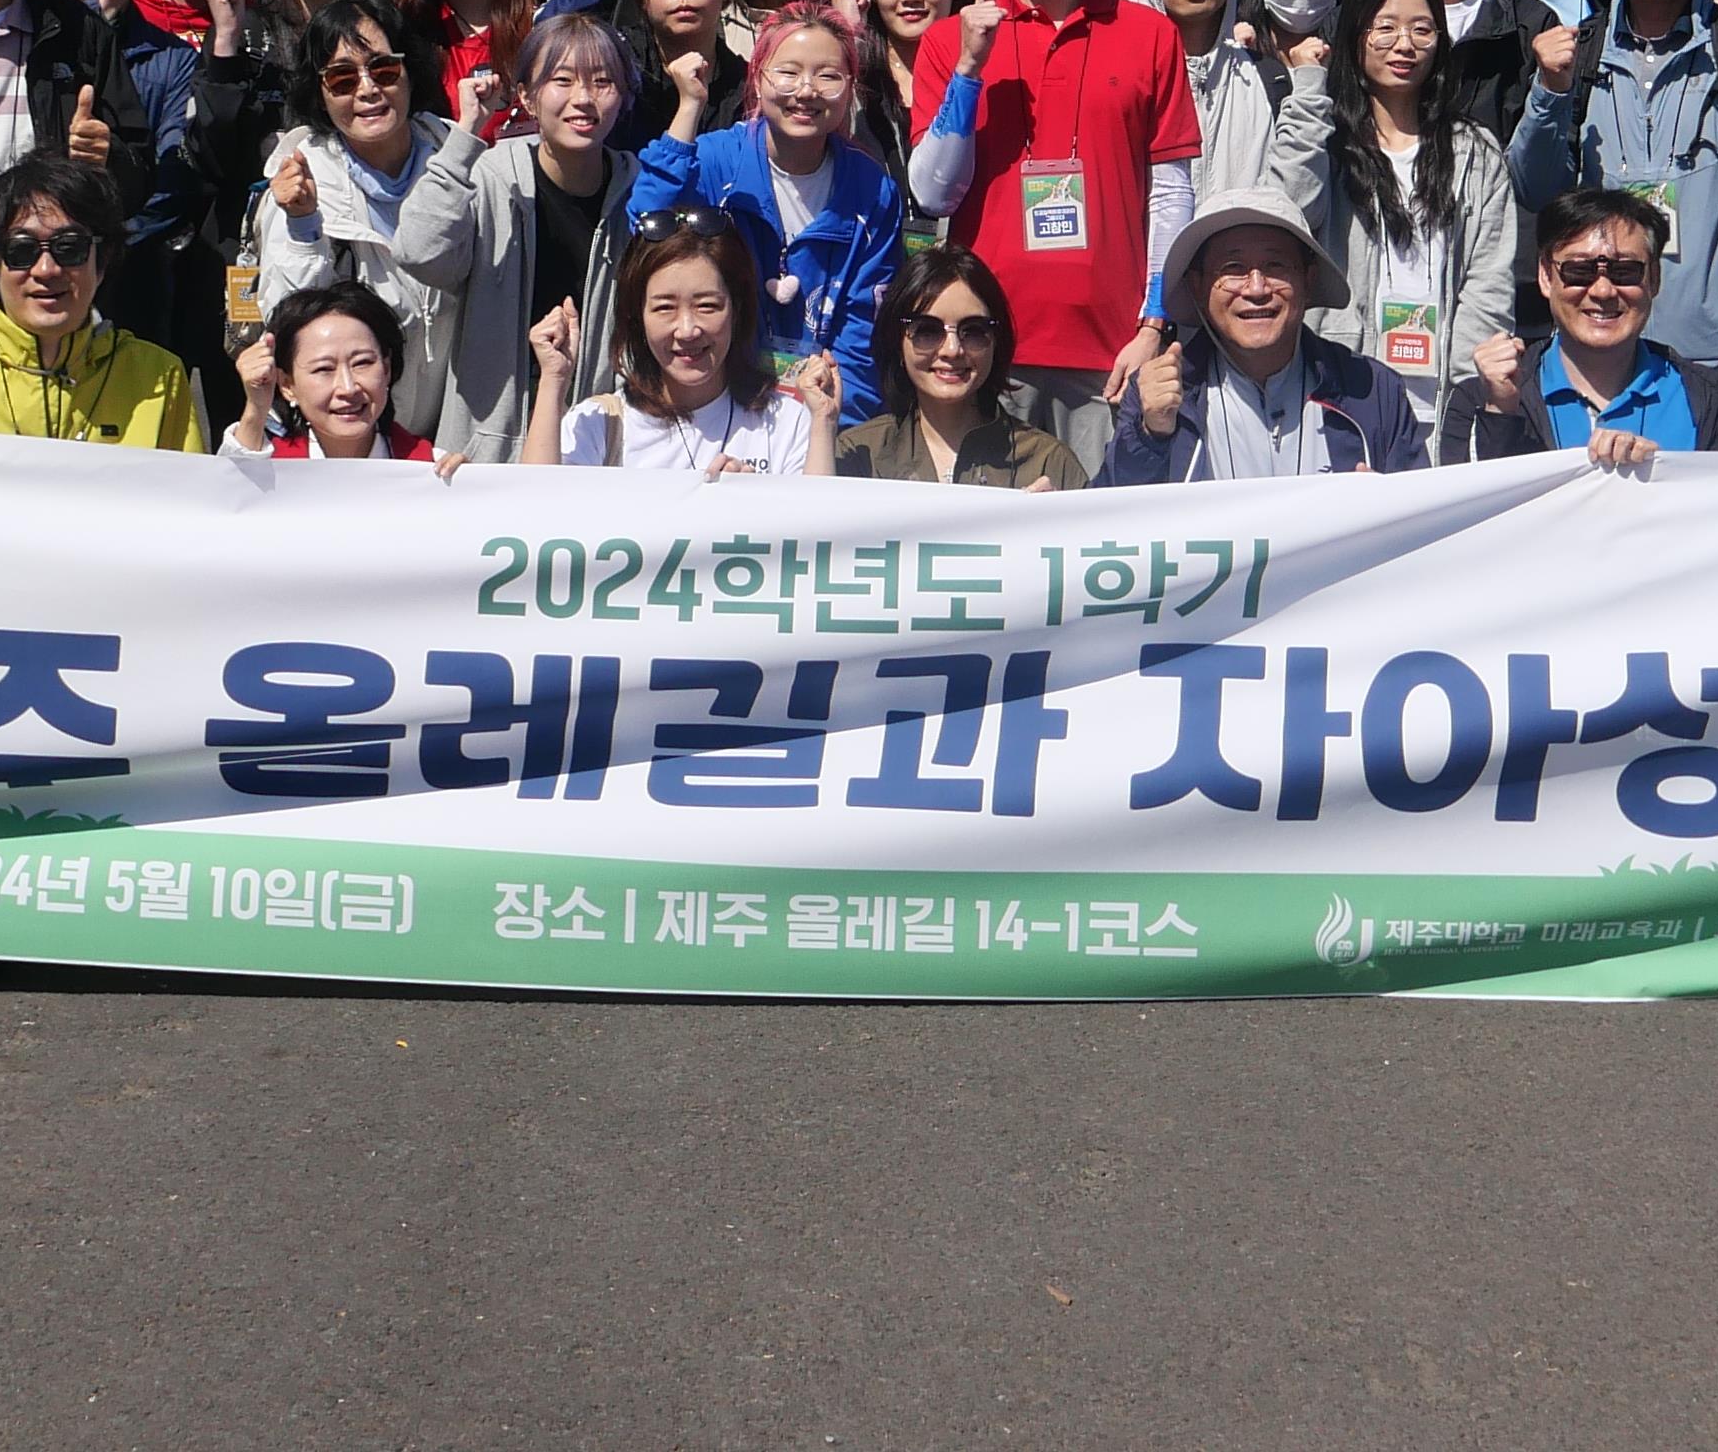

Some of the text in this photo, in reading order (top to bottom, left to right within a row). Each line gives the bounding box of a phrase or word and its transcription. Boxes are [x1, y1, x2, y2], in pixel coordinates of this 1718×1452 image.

[1039, 220, 1074, 235] 고창민
[476, 534, 1271, 635] 2024학년도 1학기
[203, 639, 1070, 818] 올레길과
[105, 860, 190, 921] 5월
[211, 865, 414, 934] 10일(금)
[493, 882, 607, 941] 장소
[655, 888, 768, 947] 제주
[786, 894, 955, 953] 올레길
[975, 899, 1199, 956] 14-1코스
[1384, 919, 1526, 947] 제주대학교
[1540, 918, 1683, 942] 미래교육과
